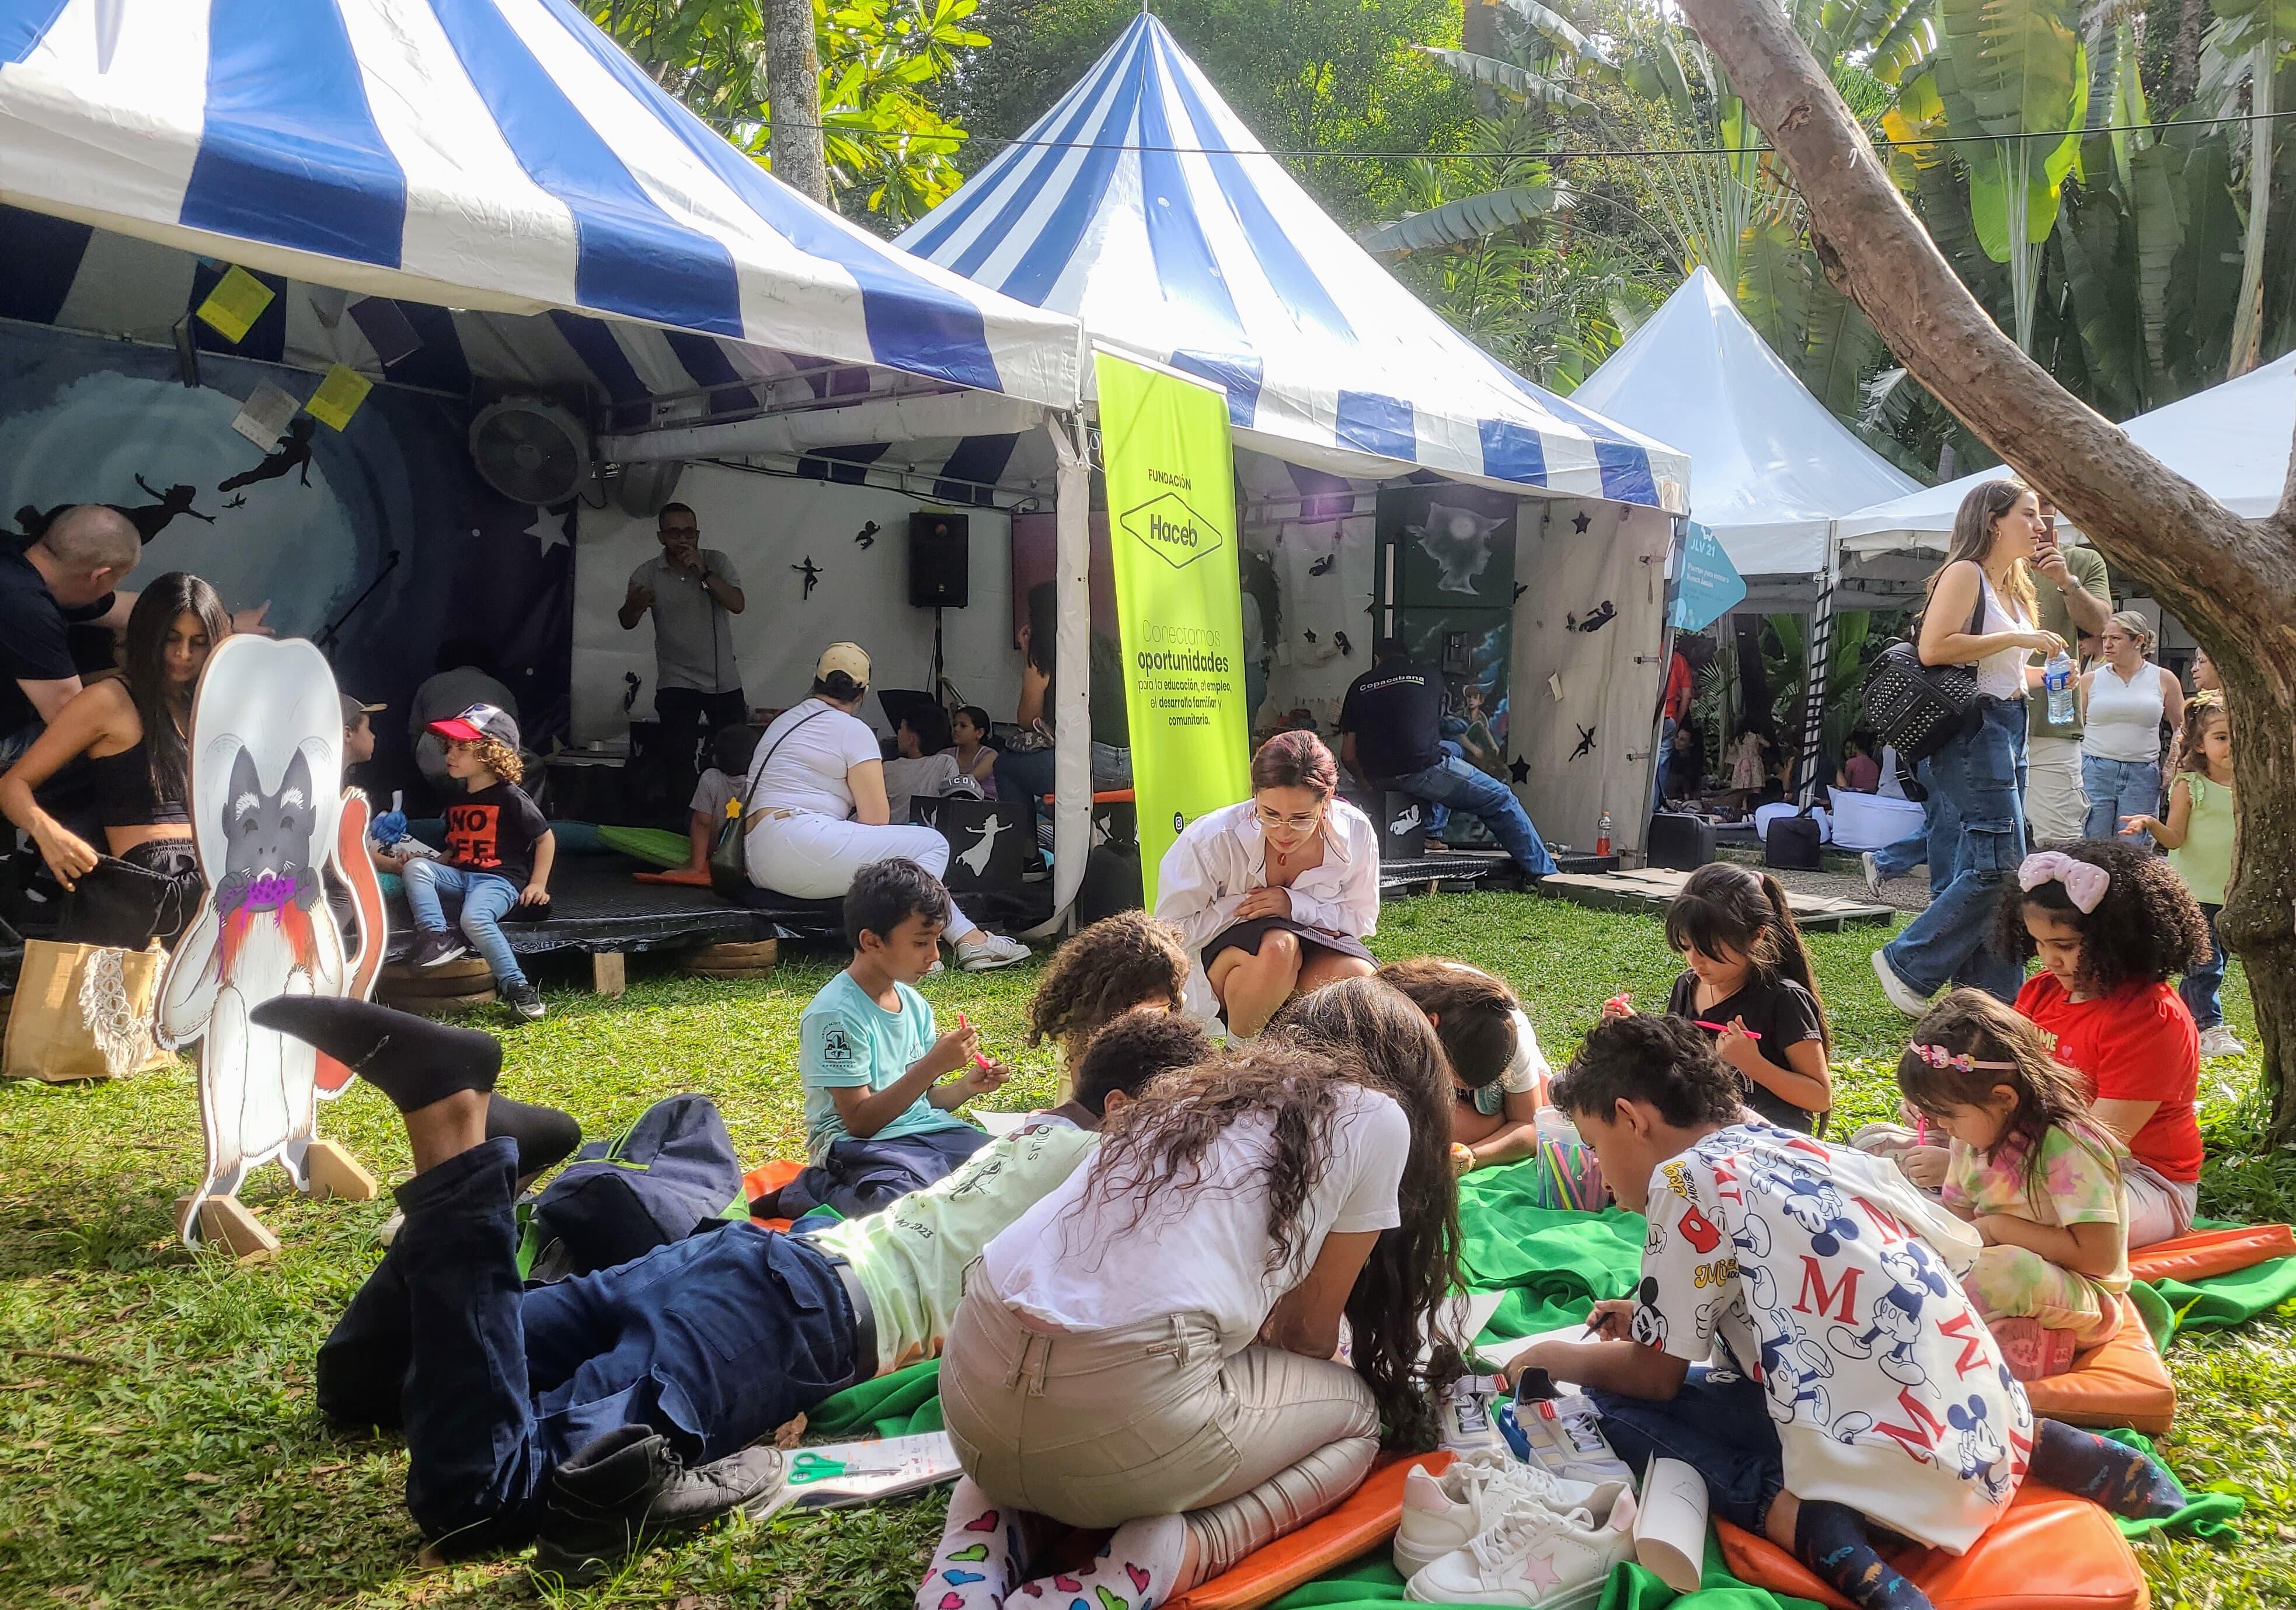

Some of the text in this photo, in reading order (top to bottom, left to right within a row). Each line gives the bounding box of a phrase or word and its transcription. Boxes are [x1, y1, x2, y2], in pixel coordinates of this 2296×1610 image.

[1148, 468, 1191, 491] FUNDACIÓN
[1150, 513, 1197, 548] Haceb
[1691, 539, 1715, 557] JLV 21
[1142, 619, 1221, 647] Conectamos
[1137, 647, 1229, 677] oportunidades
[1138, 678, 1232, 695] para la educación, el empleo,
[1359, 675, 1424, 691] Copacabana
[1150, 695, 1222, 711] el desarrollo familiar y
[1168, 713, 1210, 726] comunitario.
[949, 777, 975, 789] ICON
[451, 809, 487, 832] NO
[1661, 1161, 1688, 1198] ckey
[1682, 1168, 1701, 1203] MOUSE
[1849, 1196, 1921, 1246] M
[1792, 1254, 1865, 1326] M
[1935, 1306, 1992, 1382] M
[1871, 1385, 1947, 1465] M
